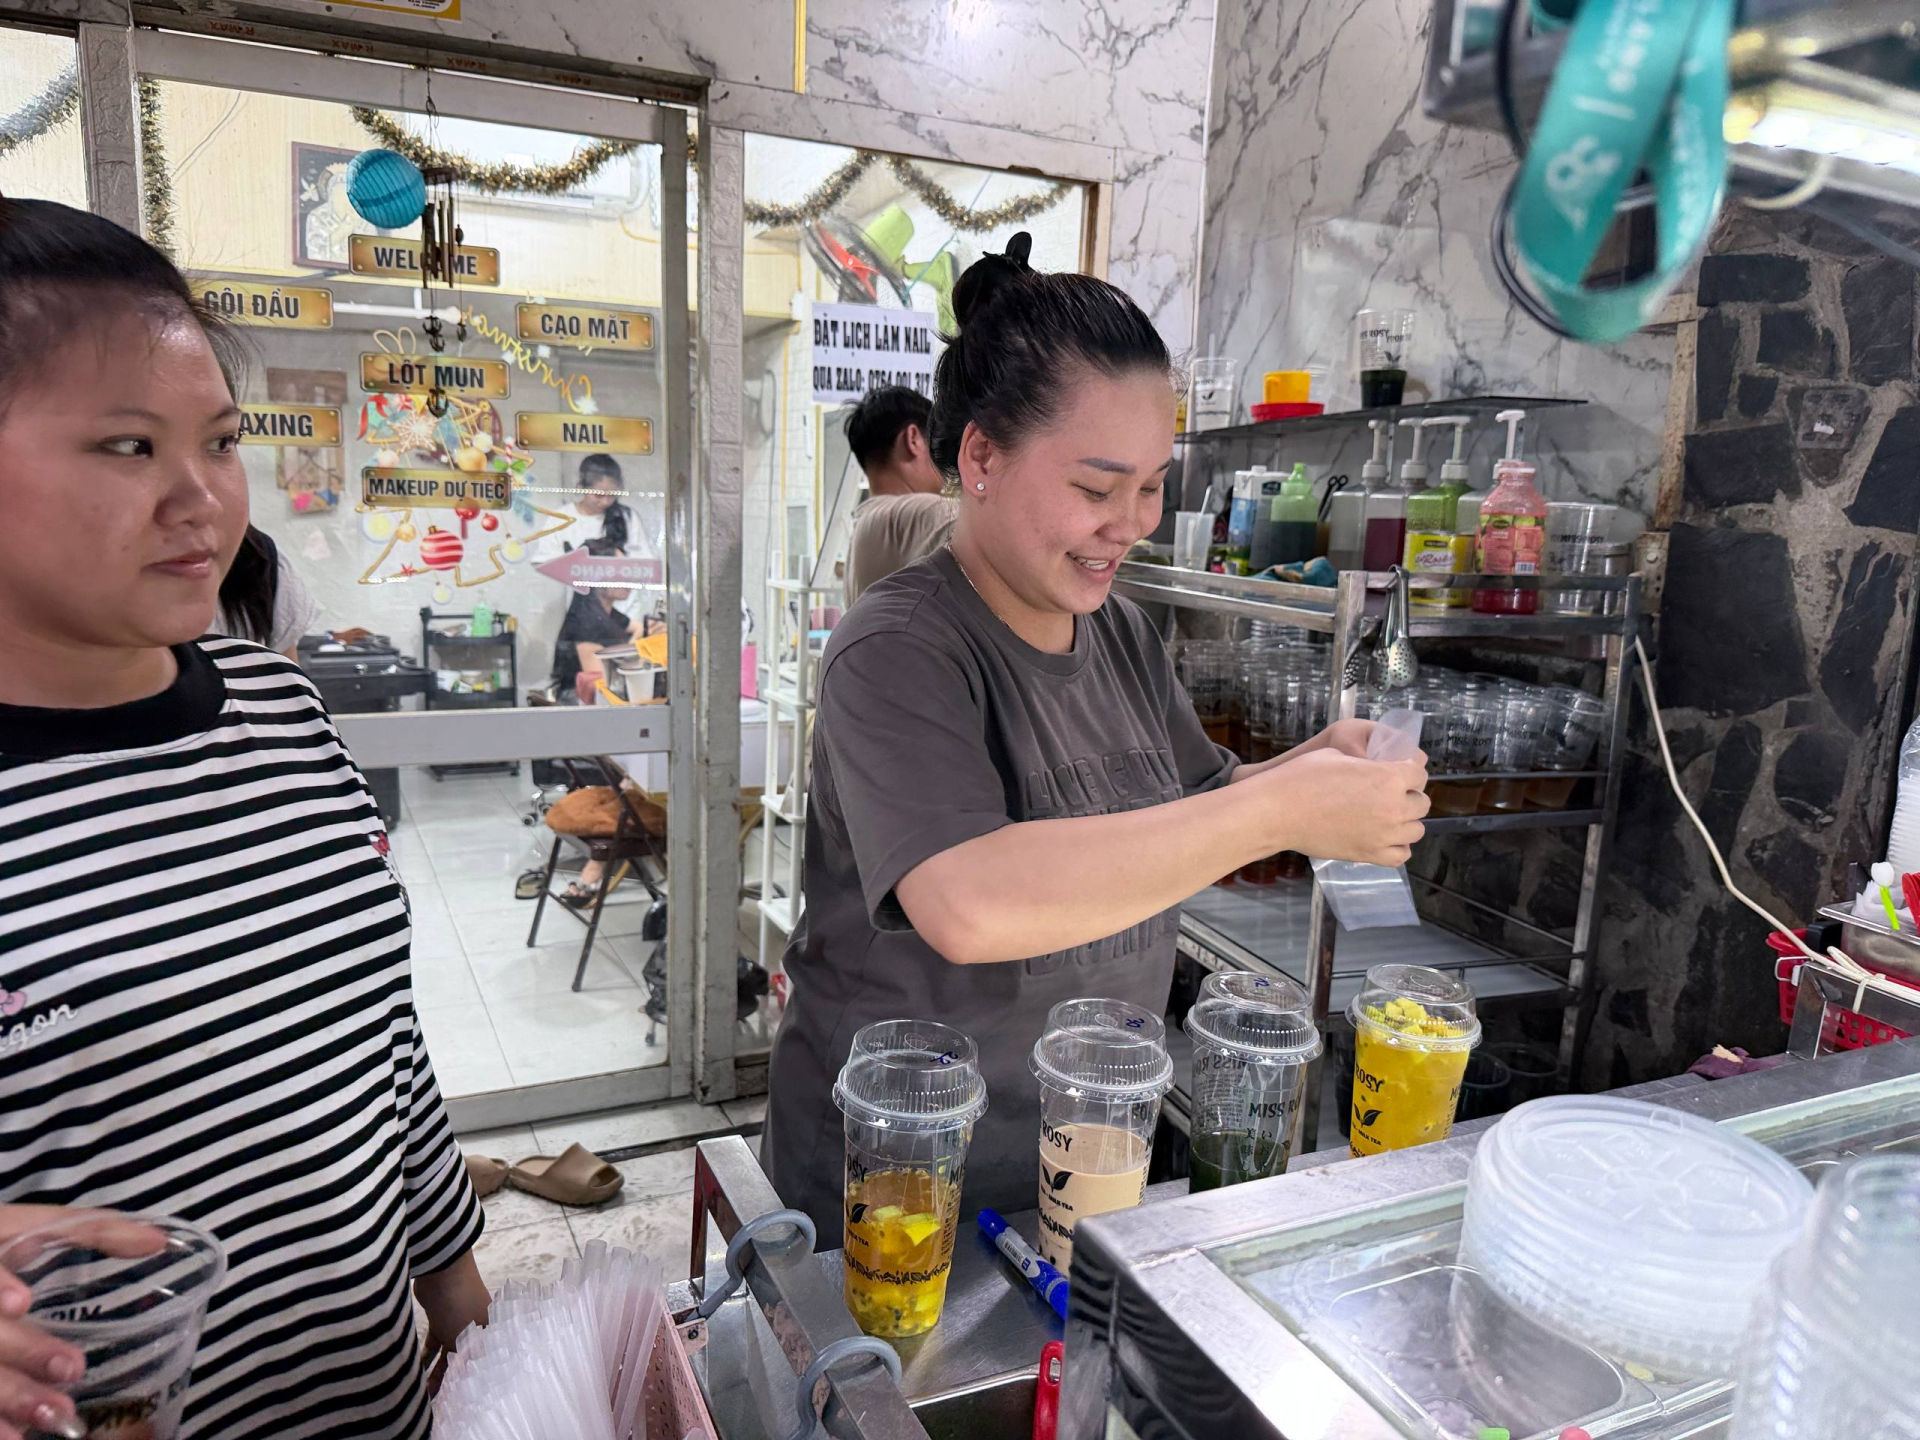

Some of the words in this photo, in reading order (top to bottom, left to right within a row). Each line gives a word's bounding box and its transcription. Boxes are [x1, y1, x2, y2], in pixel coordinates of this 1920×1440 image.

[374, 247, 477, 275] WELME
[204, 287, 243, 319] GỘI
[252, 288, 299, 319] ĐẦU
[541, 313, 581, 340] CẠO
[588, 314, 630, 343] MẶT
[843, 321, 871, 357] LỊCH
[875, 315, 900, 352] LÀM
[904, 326, 931, 354] NAIL
[388, 359, 427, 390] LỘT
[434, 366, 484, 392] MỤN
[813, 366, 832, 392] QUA
[836, 367, 865, 393] ZALO:
[240, 413, 313, 438] AXING
[563, 422, 609, 444] NAIL
[369, 478, 439, 497] MAKEUP
[444, 480, 468, 502] DỰ
[471, 479, 505, 503] TIỆC
[1248, 1102, 1285, 1118] MISS
[1042, 1119, 1073, 1152] ROSY
[1061, 1201, 1074, 1211] TEA
